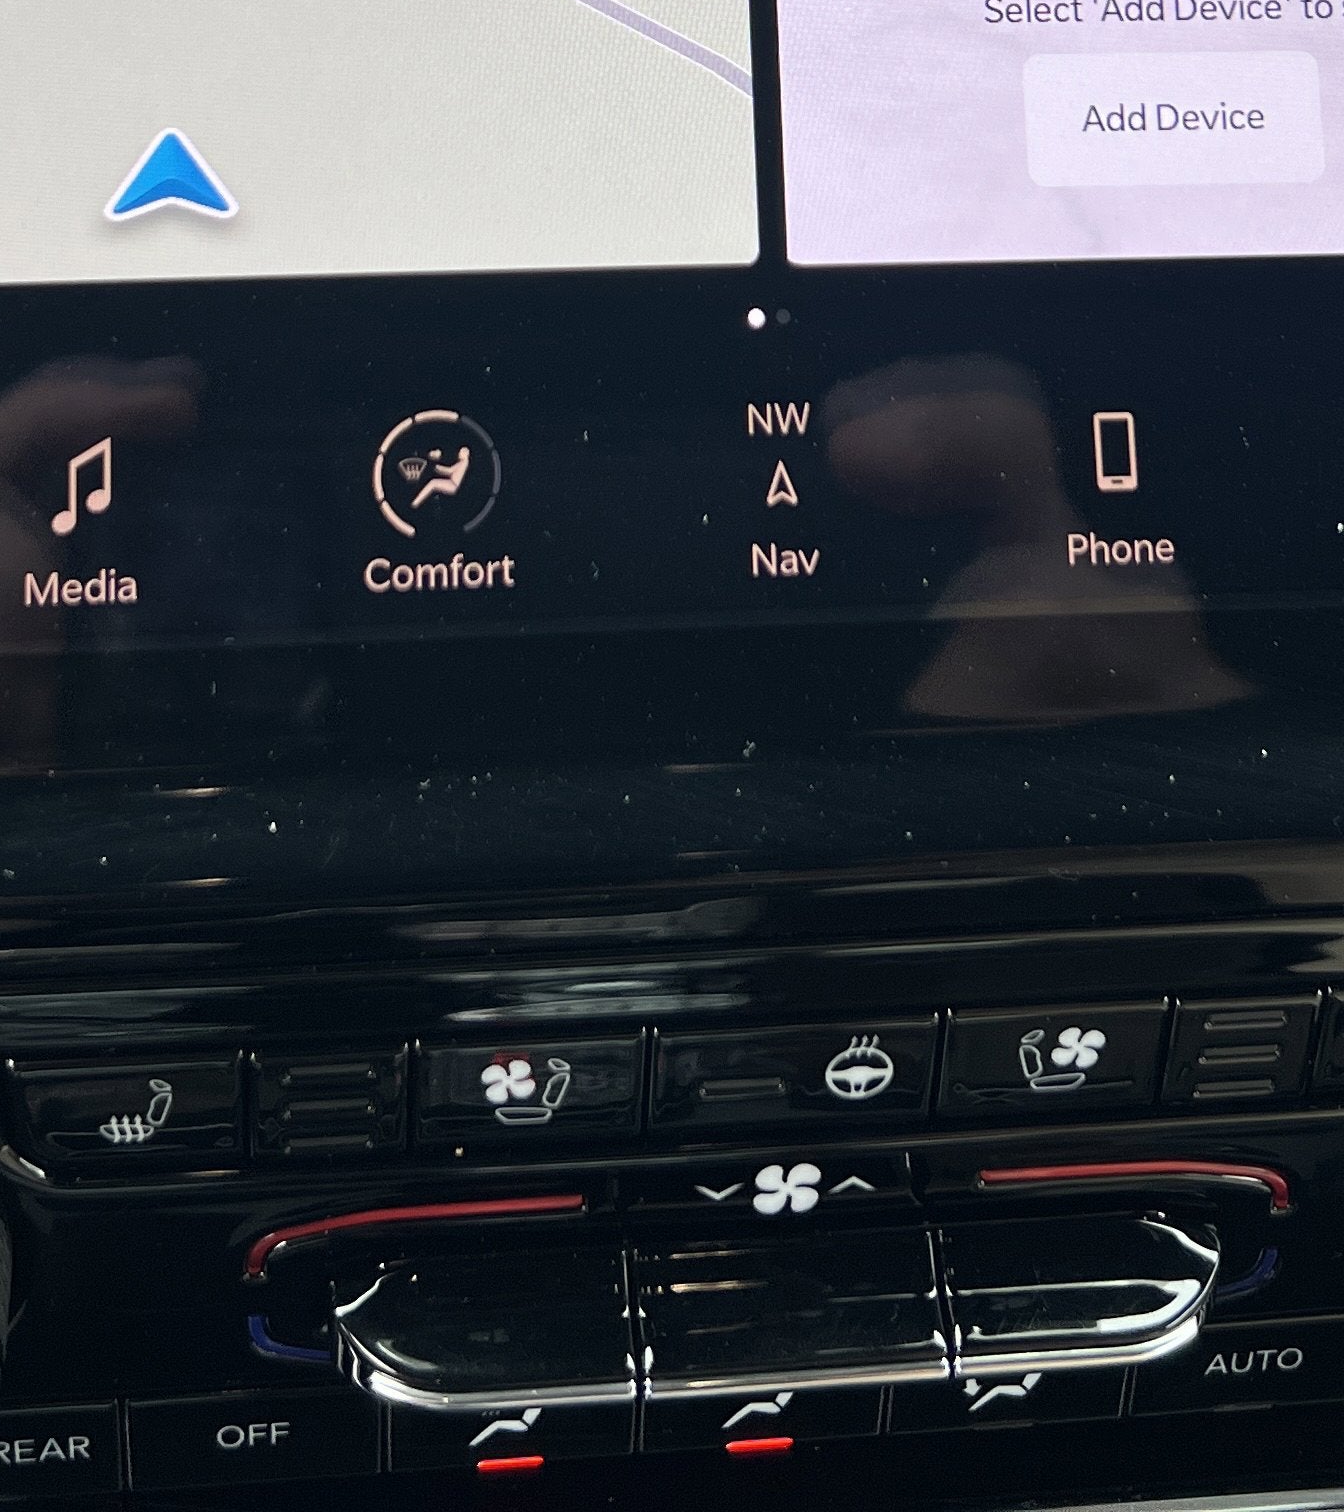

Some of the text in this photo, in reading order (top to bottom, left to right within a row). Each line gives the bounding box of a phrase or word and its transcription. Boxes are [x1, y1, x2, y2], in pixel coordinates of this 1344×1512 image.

[1081, 103, 1265, 133] Add Device
[746, 401, 811, 437] NW
[751, 540, 821, 578] Nav
[1066, 531, 1177, 566] Phone
[23, 568, 138, 608] Media
[363, 552, 516, 593] Comfort
[1205, 1347, 1304, 1376] AUTO
[216, 1422, 291, 1449] OFF
